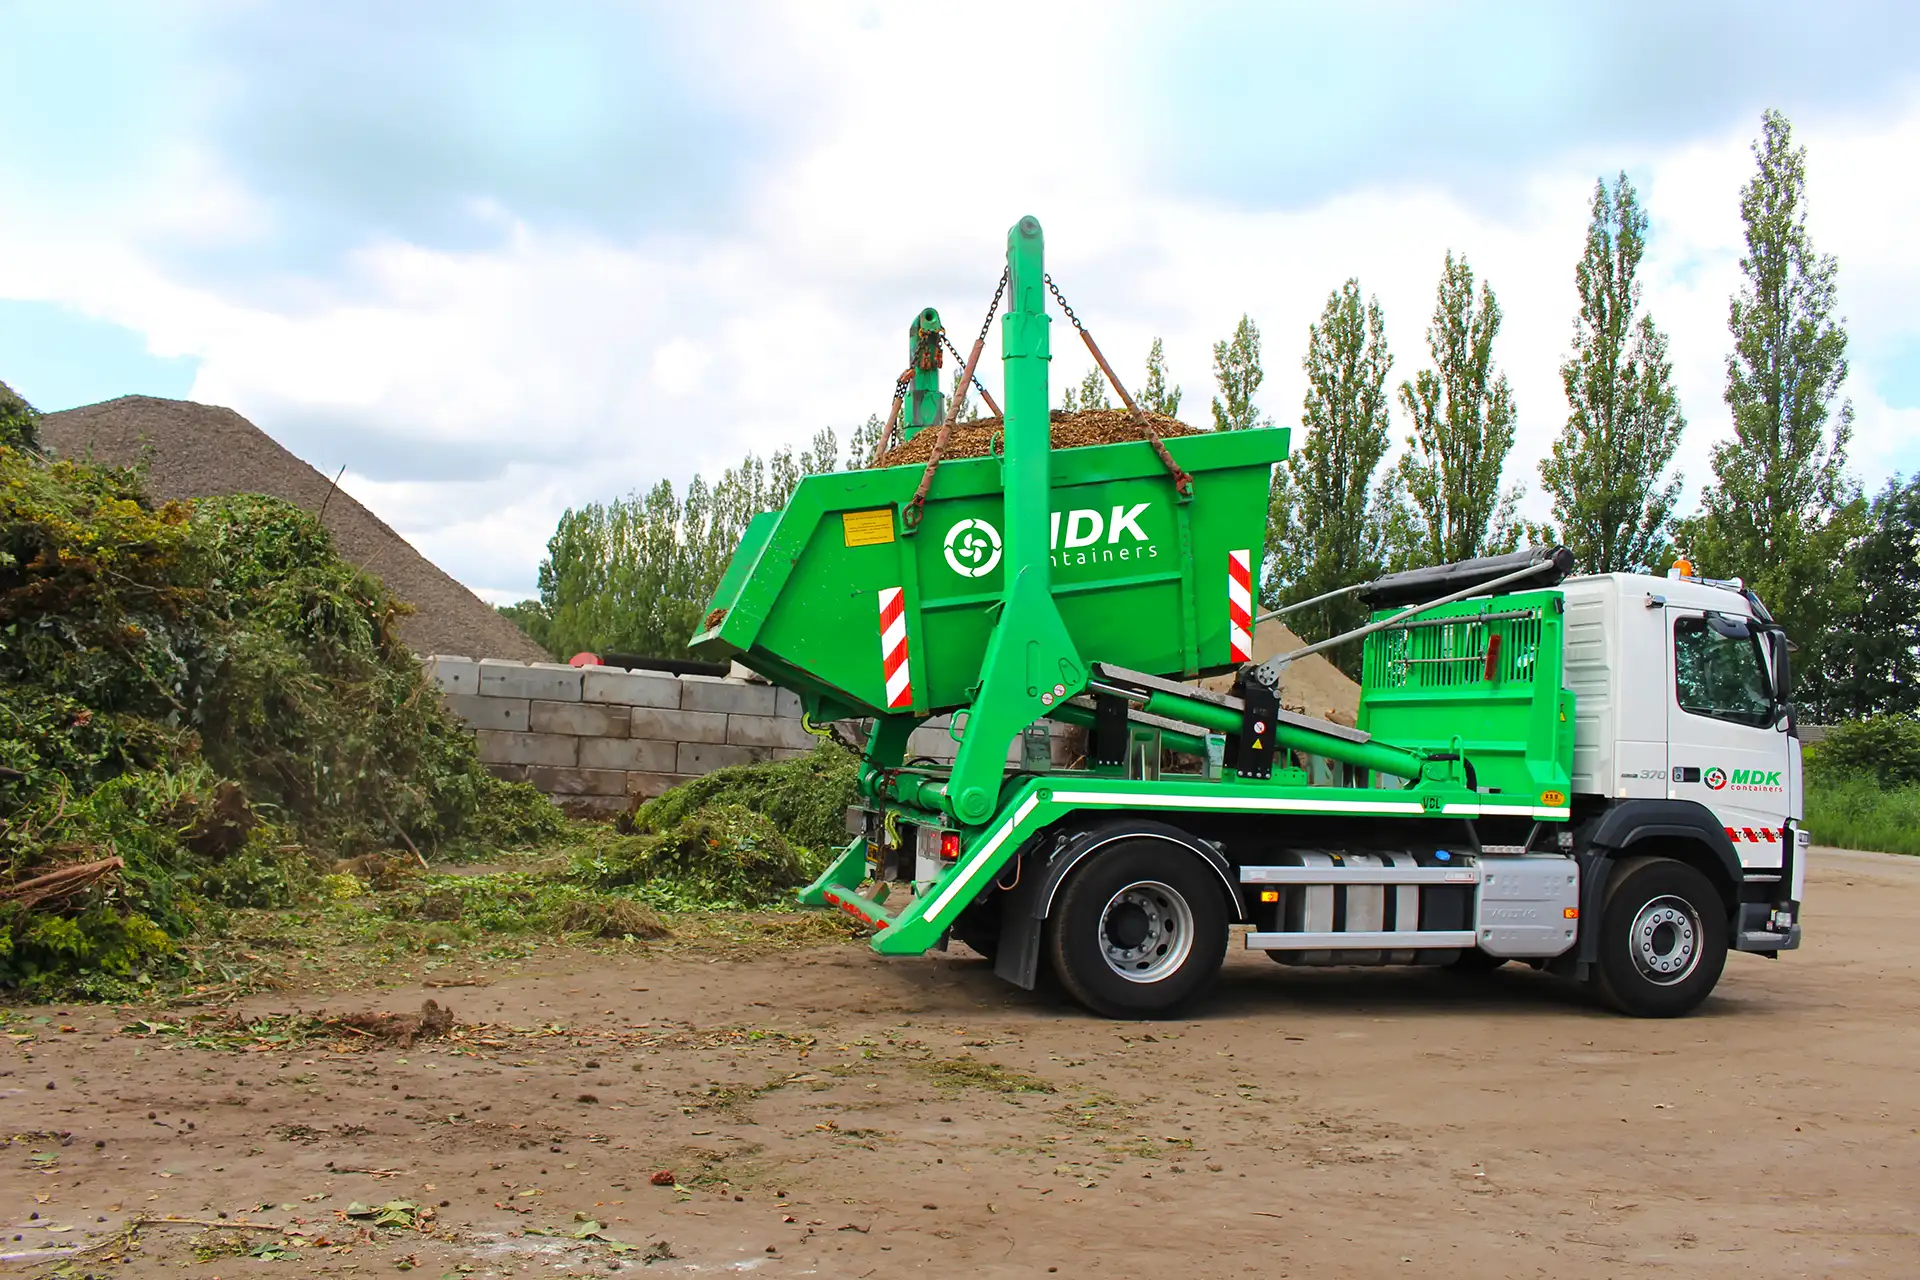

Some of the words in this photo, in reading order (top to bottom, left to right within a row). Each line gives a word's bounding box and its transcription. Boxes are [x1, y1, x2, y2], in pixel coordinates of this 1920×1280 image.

[1051, 503, 1151, 550] DK
[1051, 545, 1157, 567] ntainers
[1640, 769, 1666, 780] 370
[1731, 769, 1782, 786] MDK
